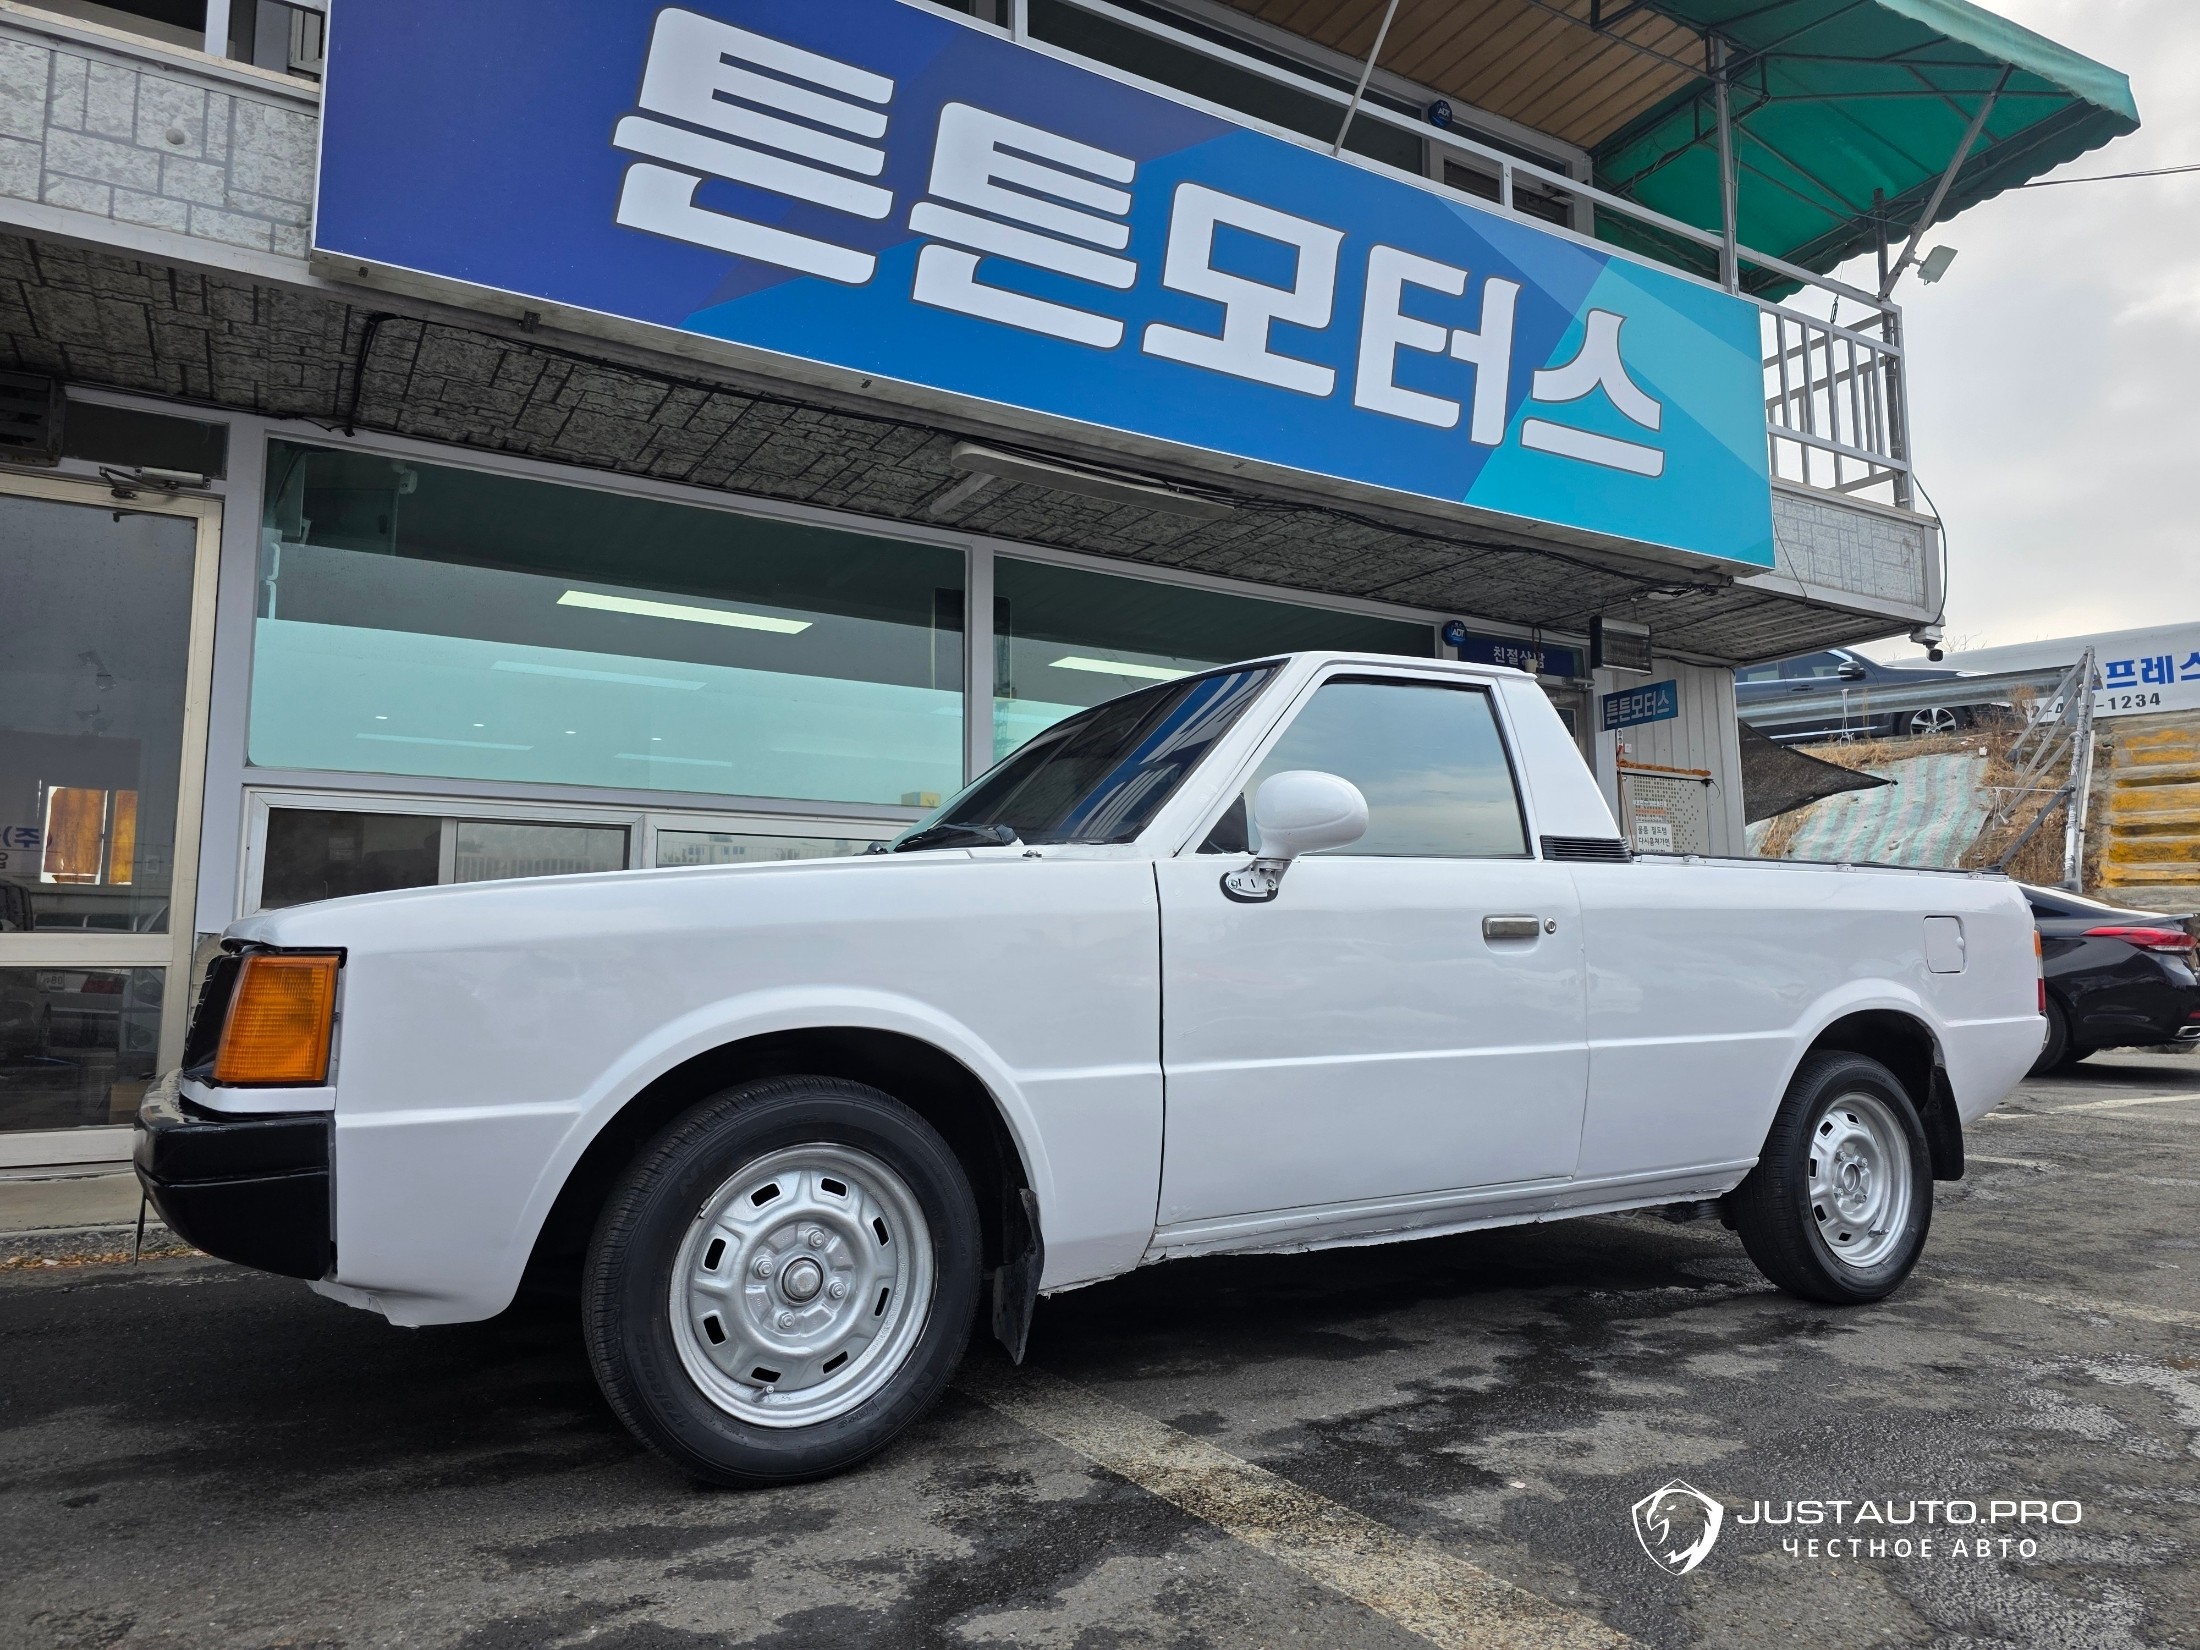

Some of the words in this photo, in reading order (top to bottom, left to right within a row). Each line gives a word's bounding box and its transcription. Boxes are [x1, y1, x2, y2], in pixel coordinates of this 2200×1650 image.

[613, 7, 1664, 477] 튼튼모터스
[1451, 628, 1465, 638] ADT
[2092, 652, 2200, 691] 프레스
[1606, 690, 1670, 725] 튼튼모터스
